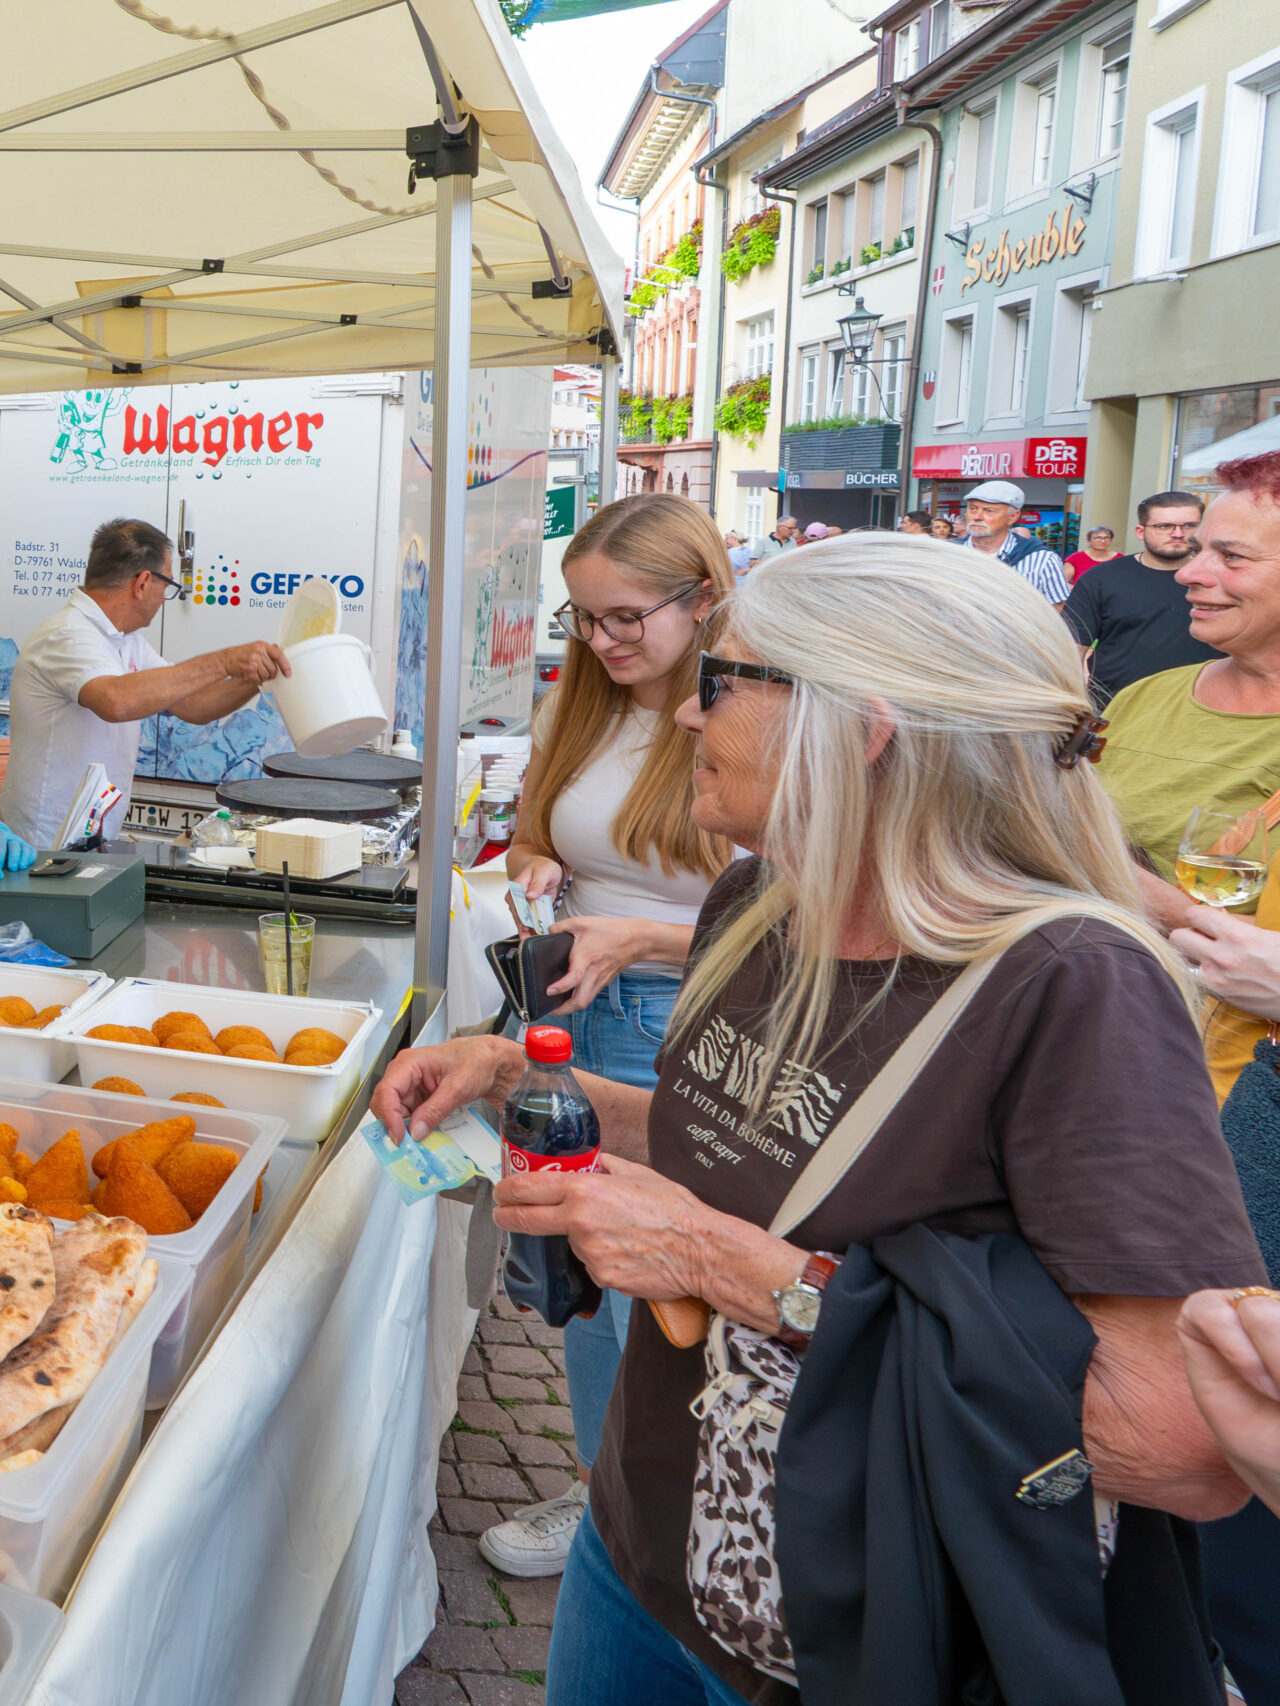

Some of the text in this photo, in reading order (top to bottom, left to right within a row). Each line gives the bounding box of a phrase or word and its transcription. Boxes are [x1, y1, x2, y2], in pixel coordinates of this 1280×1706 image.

[961, 204, 1086, 297] Scheuble
[123, 403, 324, 468] Wagner
[1035, 446, 1078, 461] DER
[120, 456, 322, 469] Getränkeland Erfrisch Dir den Tag
[1035, 463, 1077, 475] TOUR
[49, 472, 179, 484] www.getraenkeland-wagner.de
[846, 472, 898, 485] BÜCHER
[15, 541, 59, 552] Badstr. 31
[14, 555, 53, 567] D-79761
[14, 570, 30, 580] Tel.
[32, 571, 39, 581] 0
[42, 572, 53, 582] 77
[13, 585, 29, 595] Fax
[32, 586, 38, 596] 0
[41, 587, 53, 596] 77
[251, 572, 364, 598] GEFO
[249, 598, 263, 608] Die
[266, 599, 288, 609] Getr
[491, 606, 535, 680] Wagner
[159, 808, 170, 827] W
[673, 1079, 691, 1098] LA
[691, 1091, 719, 1118] VITA
[718, 1110, 737, 1131] DA
[694, 1151, 715, 1170] ITALY
